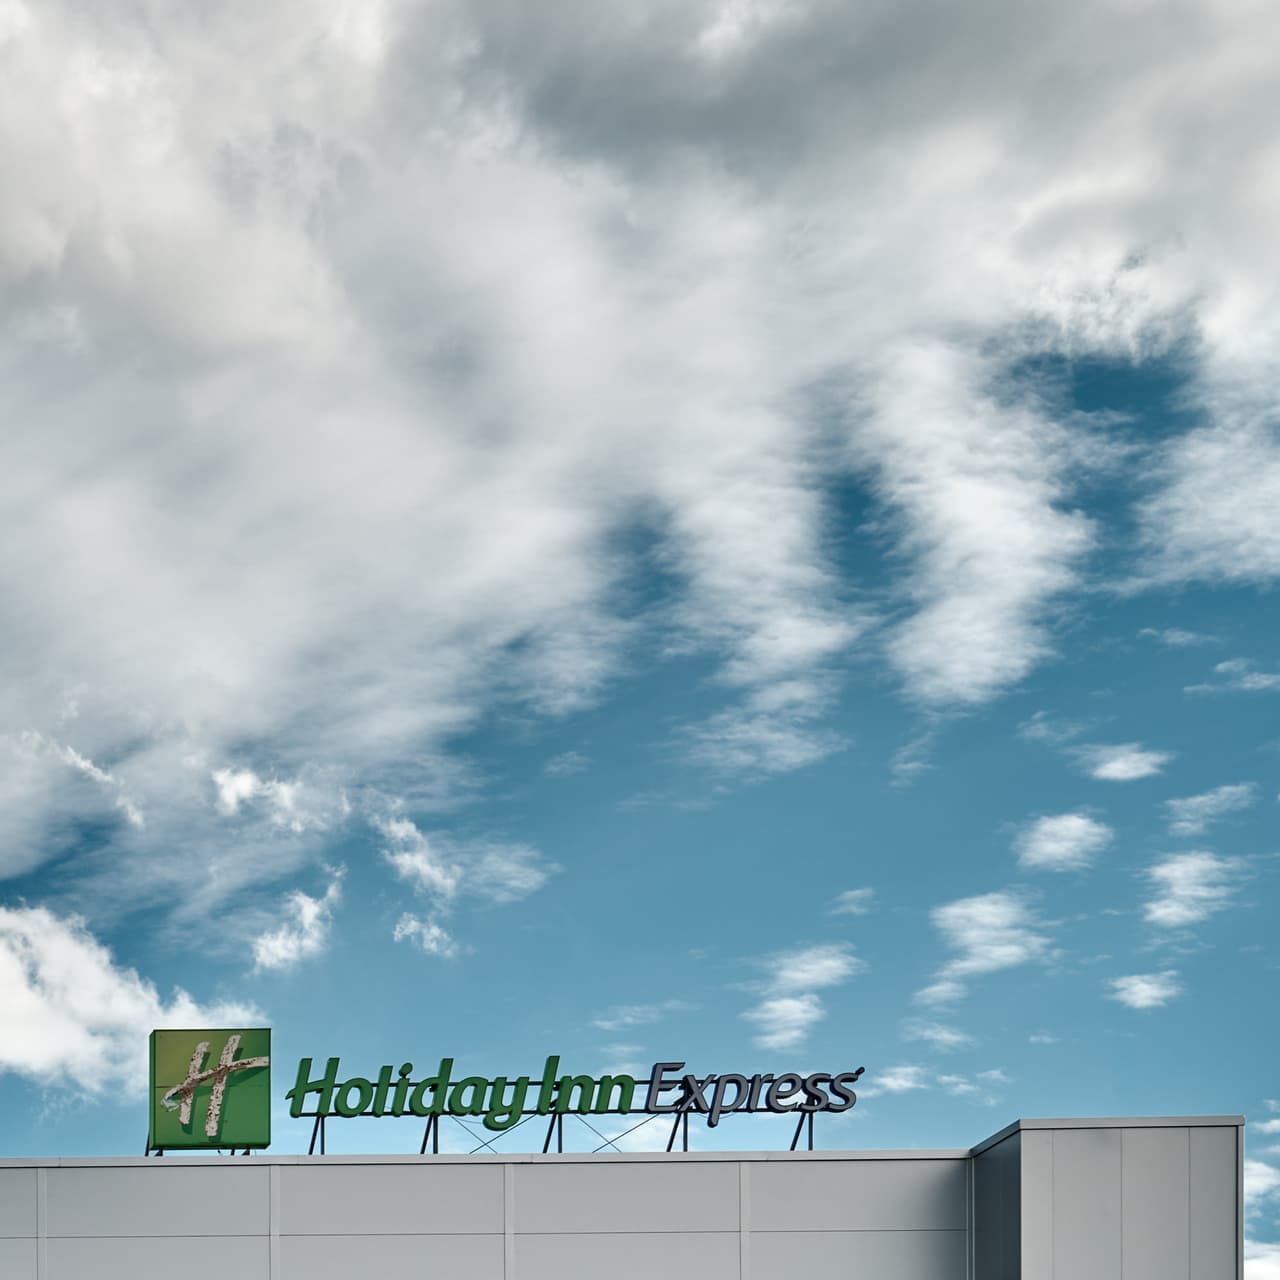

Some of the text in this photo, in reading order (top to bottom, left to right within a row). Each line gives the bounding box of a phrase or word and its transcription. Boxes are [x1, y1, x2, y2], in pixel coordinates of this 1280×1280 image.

[285, 1055, 865, 1131] Holiday Inn Express
